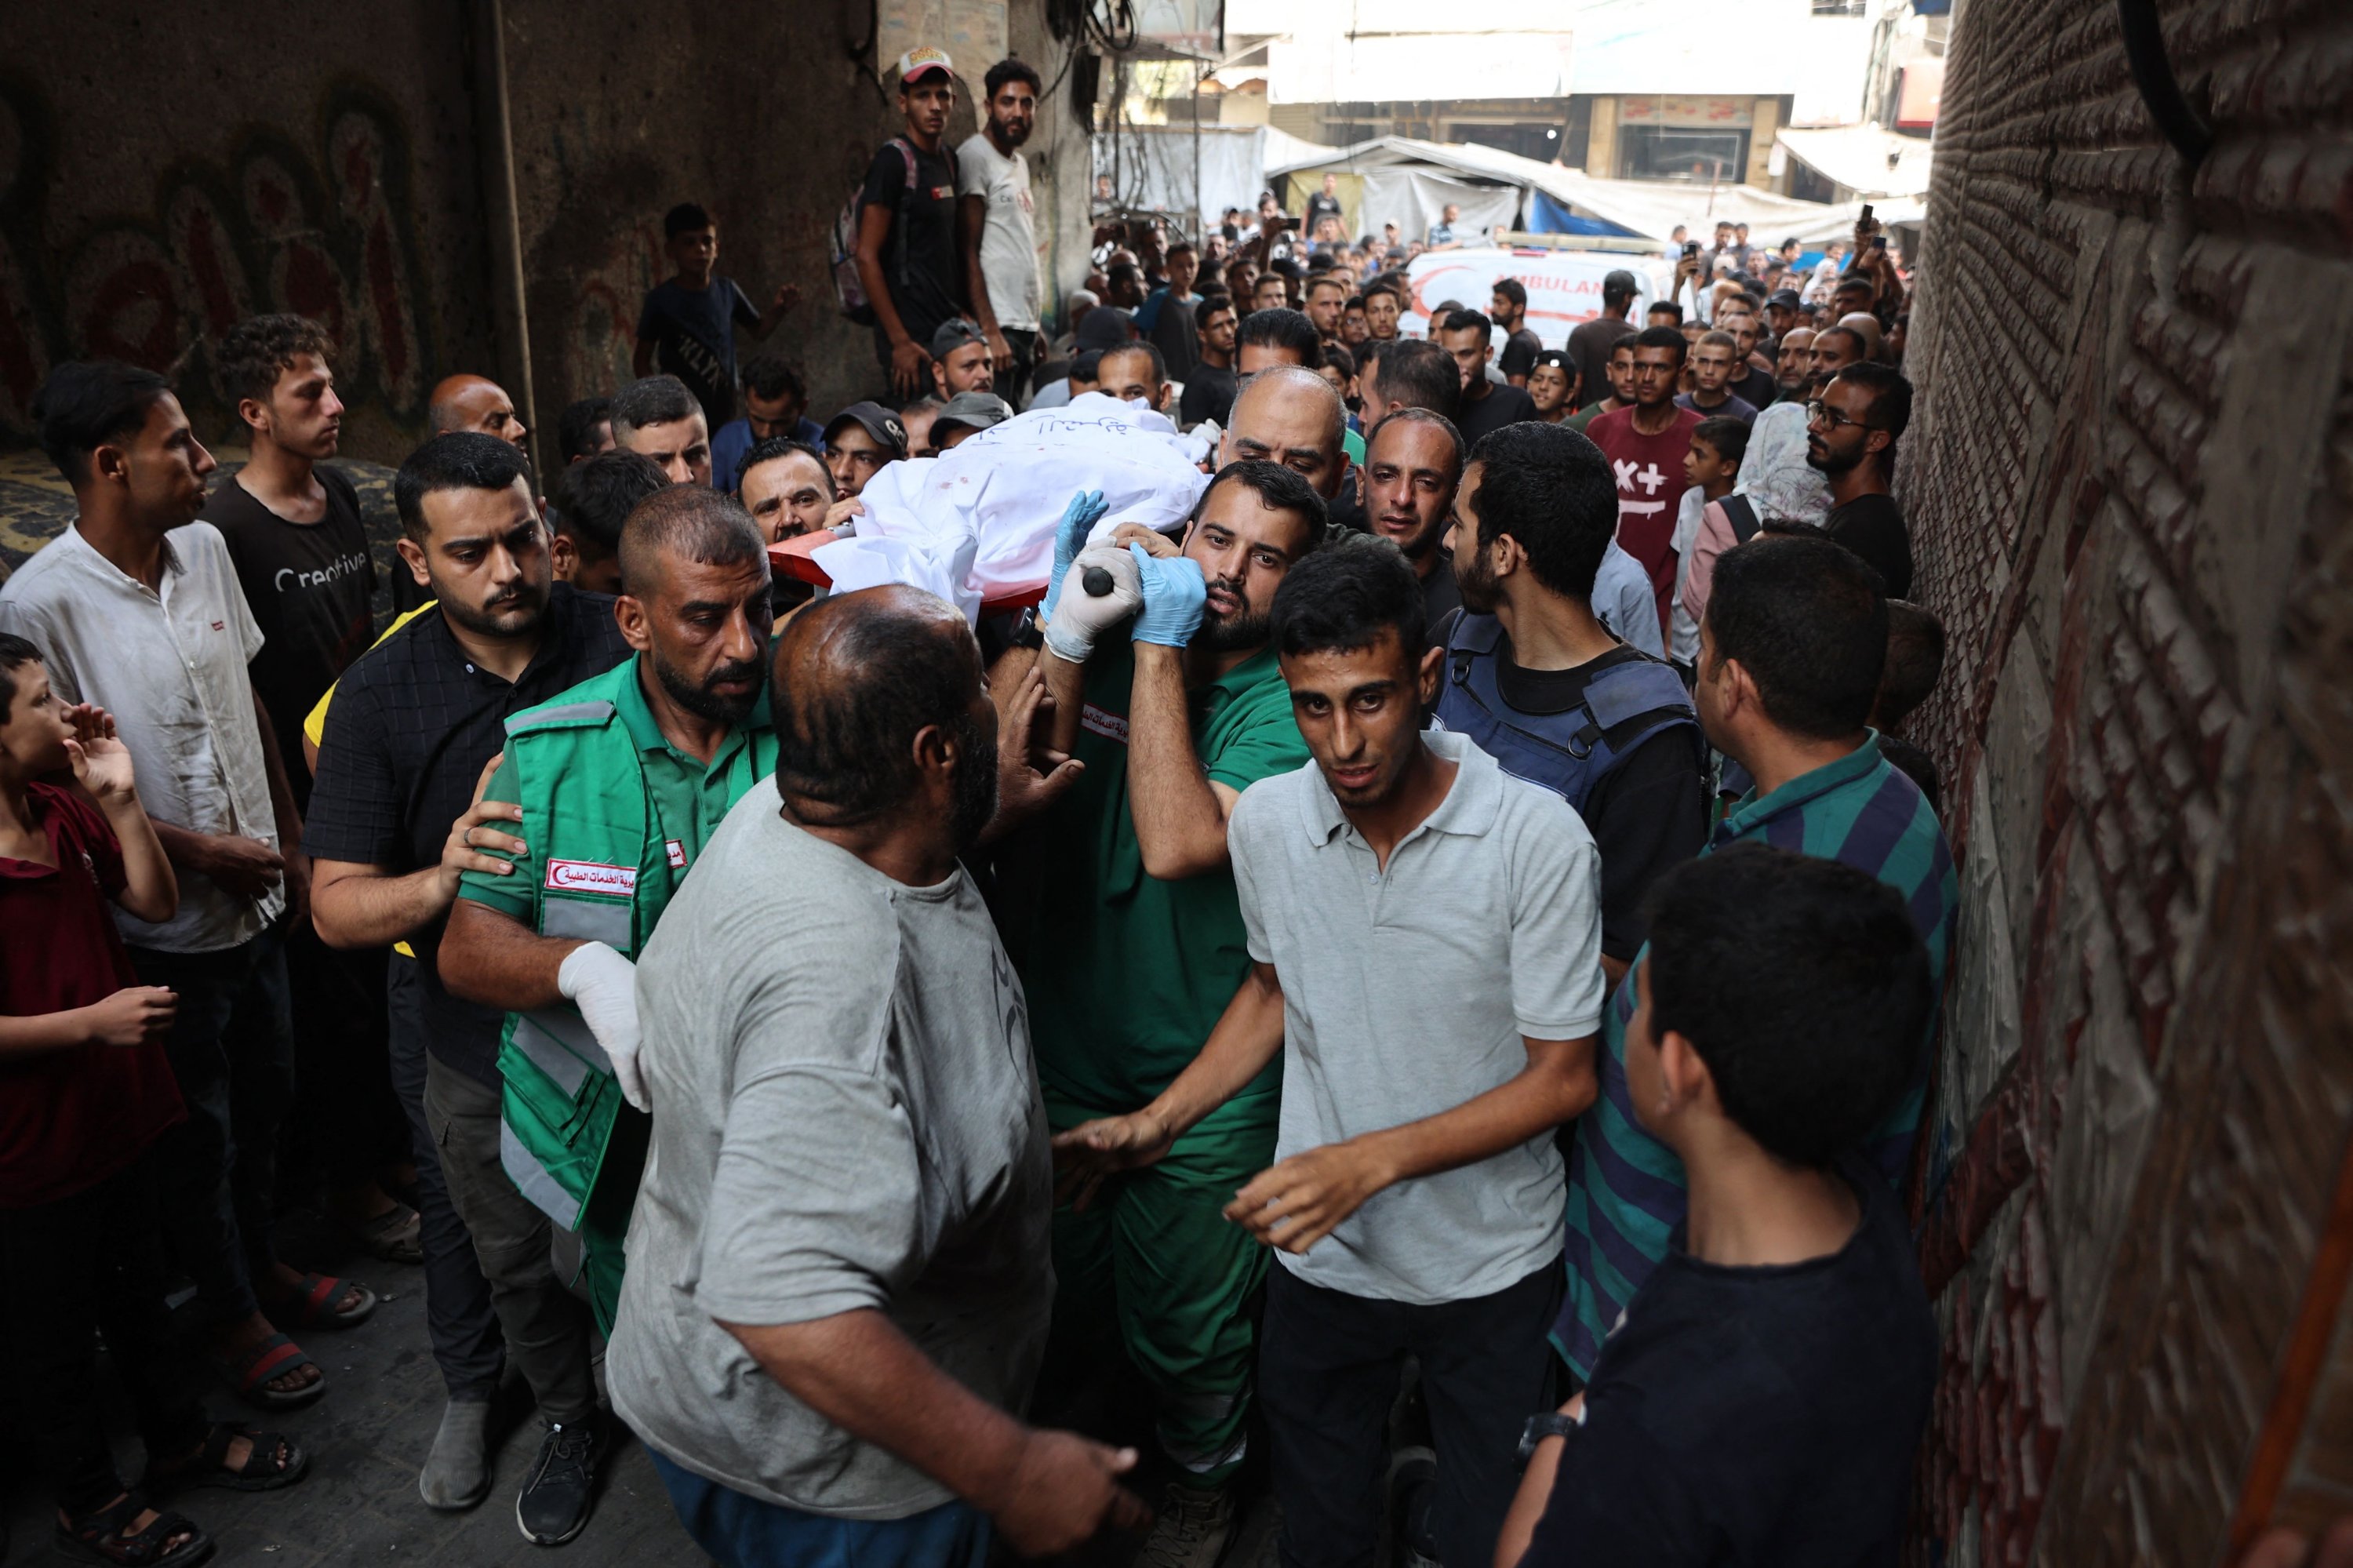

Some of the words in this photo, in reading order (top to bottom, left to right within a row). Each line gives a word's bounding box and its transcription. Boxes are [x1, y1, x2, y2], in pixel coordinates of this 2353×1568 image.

[1493, 274, 1604, 296] AMBULAN
[1092, 715, 1115, 729] الخدمات
[565, 868, 588, 883] الطبية
[589, 872, 619, 884] الخدمات
[620, 875, 635, 889] يرية
